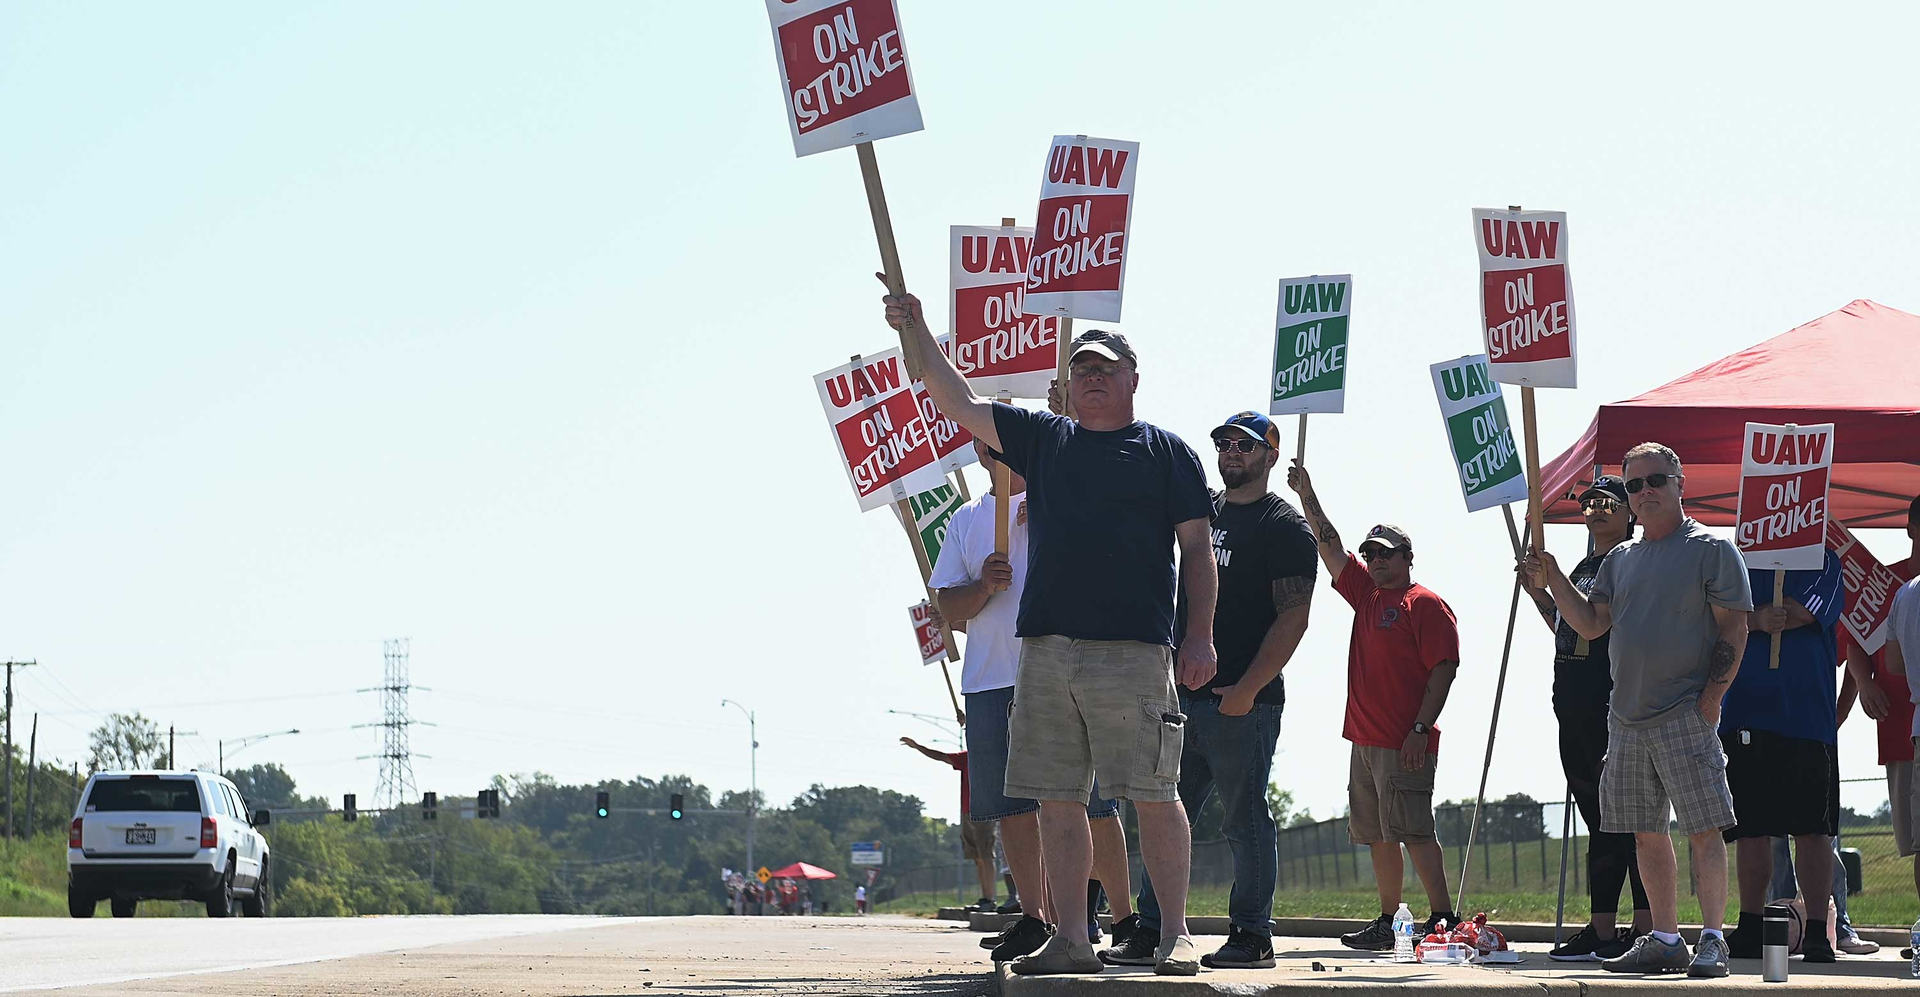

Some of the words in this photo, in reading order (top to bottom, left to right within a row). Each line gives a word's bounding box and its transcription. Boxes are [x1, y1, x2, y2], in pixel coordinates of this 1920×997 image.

[813, 6, 859, 64] ON
[794, 29, 903, 129] STRIKE
[1049, 145, 1129, 189] UAW
[1054, 200, 1091, 242] ON
[1482, 218, 1559, 259] UAW
[1027, 231, 1124, 290] STRIKE
[983, 287, 1023, 329] ON
[1285, 282, 1346, 315] UAW
[1504, 273, 1534, 314] ON
[957, 315, 1056, 374] STRIKE
[1295, 323, 1322, 358] ON
[1488, 300, 1568, 359] STRIKE
[825, 357, 900, 408] UAW
[1275, 344, 1346, 397] STRIKE
[860, 405, 894, 447] ON
[1472, 405, 1499, 445] ON
[853, 416, 927, 493] STRIKE
[1462, 426, 1515, 492] STRIKE
[1751, 432, 1827, 465] UAW
[1766, 476, 1801, 511] ON
[1738, 497, 1824, 549] STRIKE
[1842, 555, 1866, 593] ON
[1848, 562, 1894, 636] STRIKE
